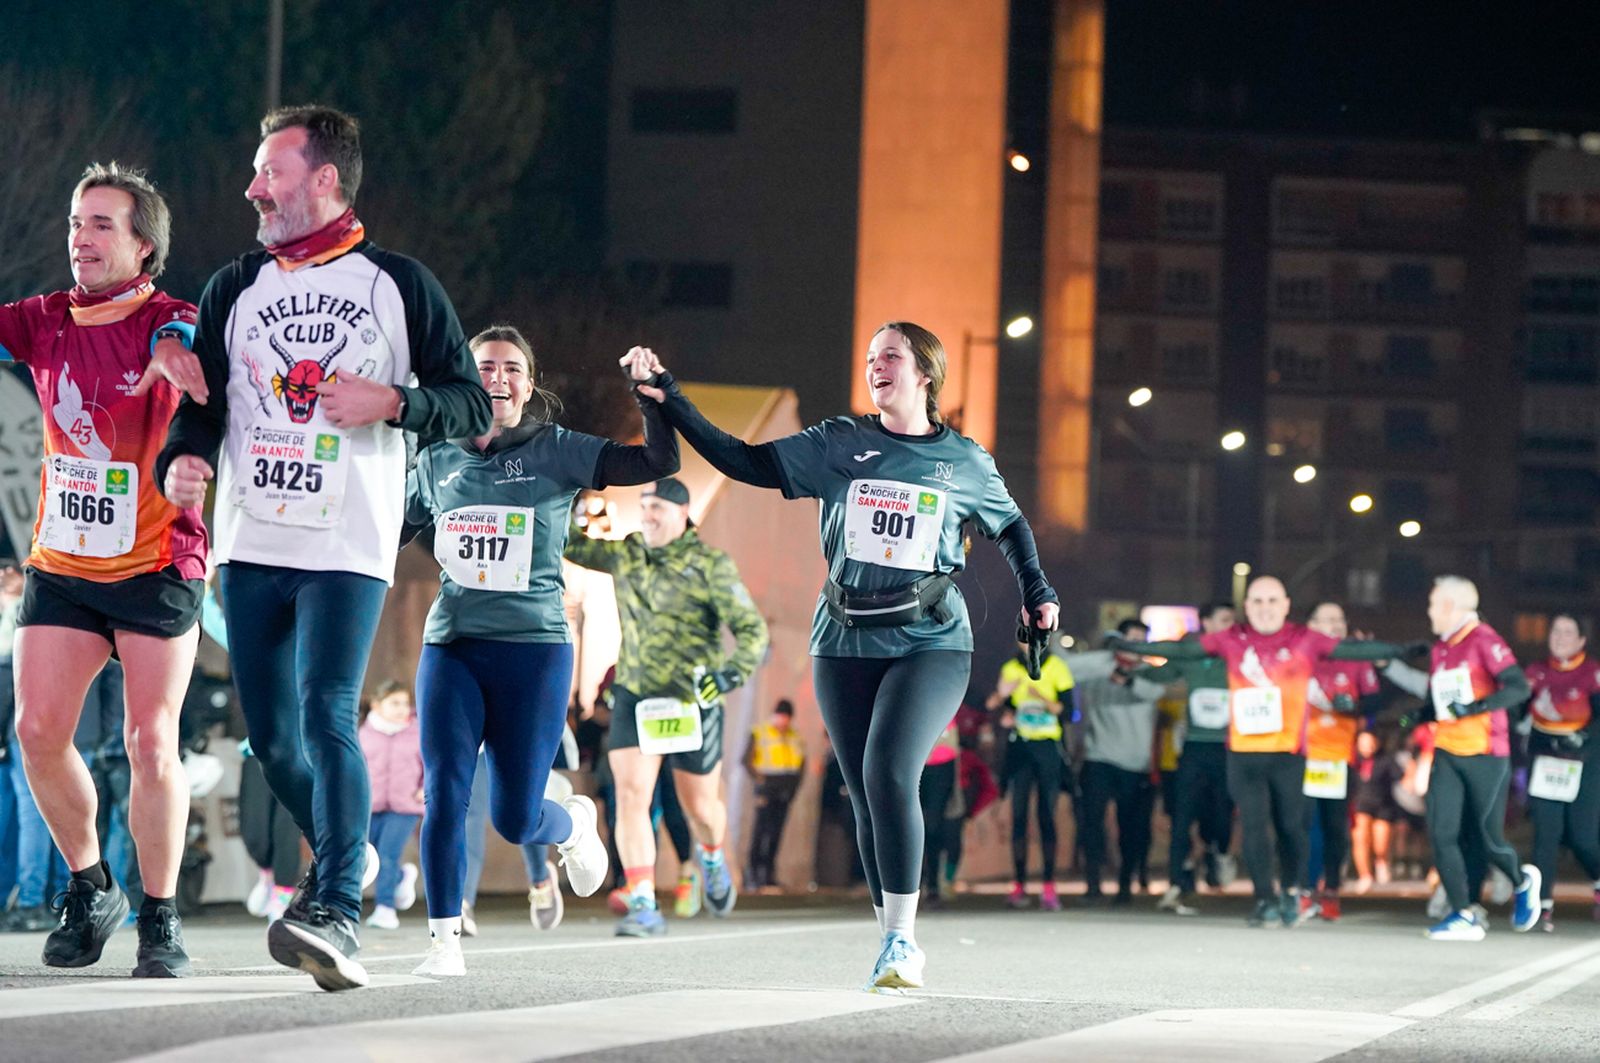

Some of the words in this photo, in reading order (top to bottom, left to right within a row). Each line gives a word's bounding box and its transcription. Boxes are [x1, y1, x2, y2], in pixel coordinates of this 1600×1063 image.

[284, 322, 335, 344] CLUB
[70, 417, 92, 446] 43
[262, 432, 290, 444] NOCHE
[292, 435, 305, 446] DE
[250, 444, 266, 455] SAN
[268, 445, 304, 459] ANTÓN
[87, 470, 98, 480] DE
[253, 458, 323, 494] 3425
[54, 475, 67, 488] SAN
[67, 480, 97, 493] ANTÓN
[870, 488, 898, 499] NOCHE
[899, 492, 910, 501] DE
[58, 490, 114, 525] 1666
[857, 496, 877, 507] SAN
[877, 499, 910, 512] ANTÓN
[458, 514, 486, 522] NOCHE
[487, 515, 498, 524] DE
[871, 509, 916, 540] 901
[447, 523, 465, 532] SAN
[458, 534, 509, 561] 3117
[658, 719, 680, 733] 772
